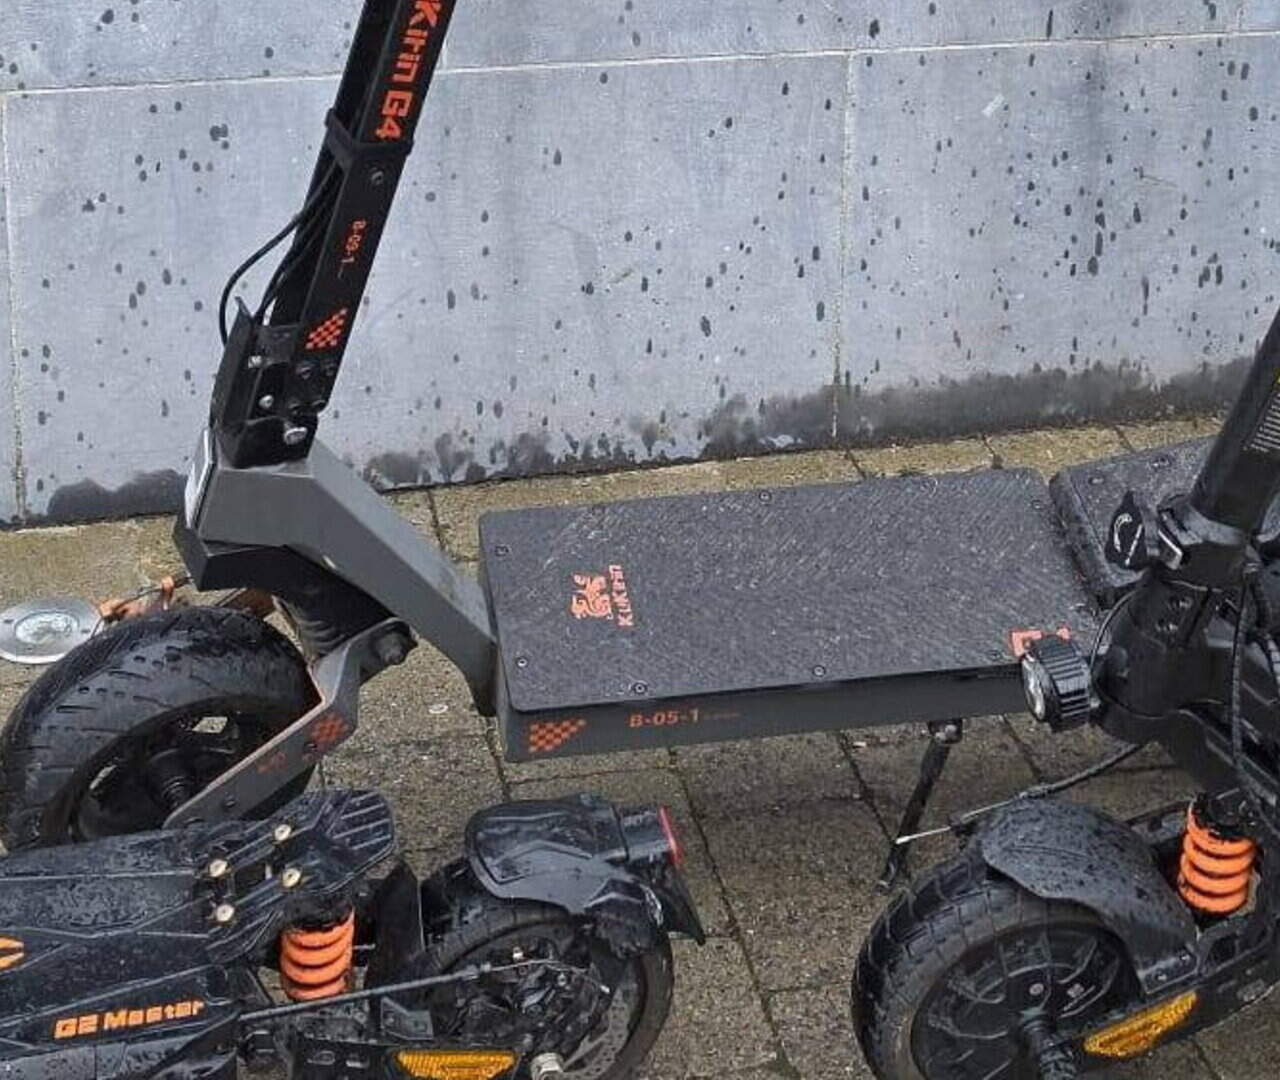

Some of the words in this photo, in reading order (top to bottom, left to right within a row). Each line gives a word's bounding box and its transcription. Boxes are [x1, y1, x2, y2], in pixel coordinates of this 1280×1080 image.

[375, 90, 413, 139] G4
[54, 1015, 98, 1040] G2
[103, 1001, 205, 1030] Master
